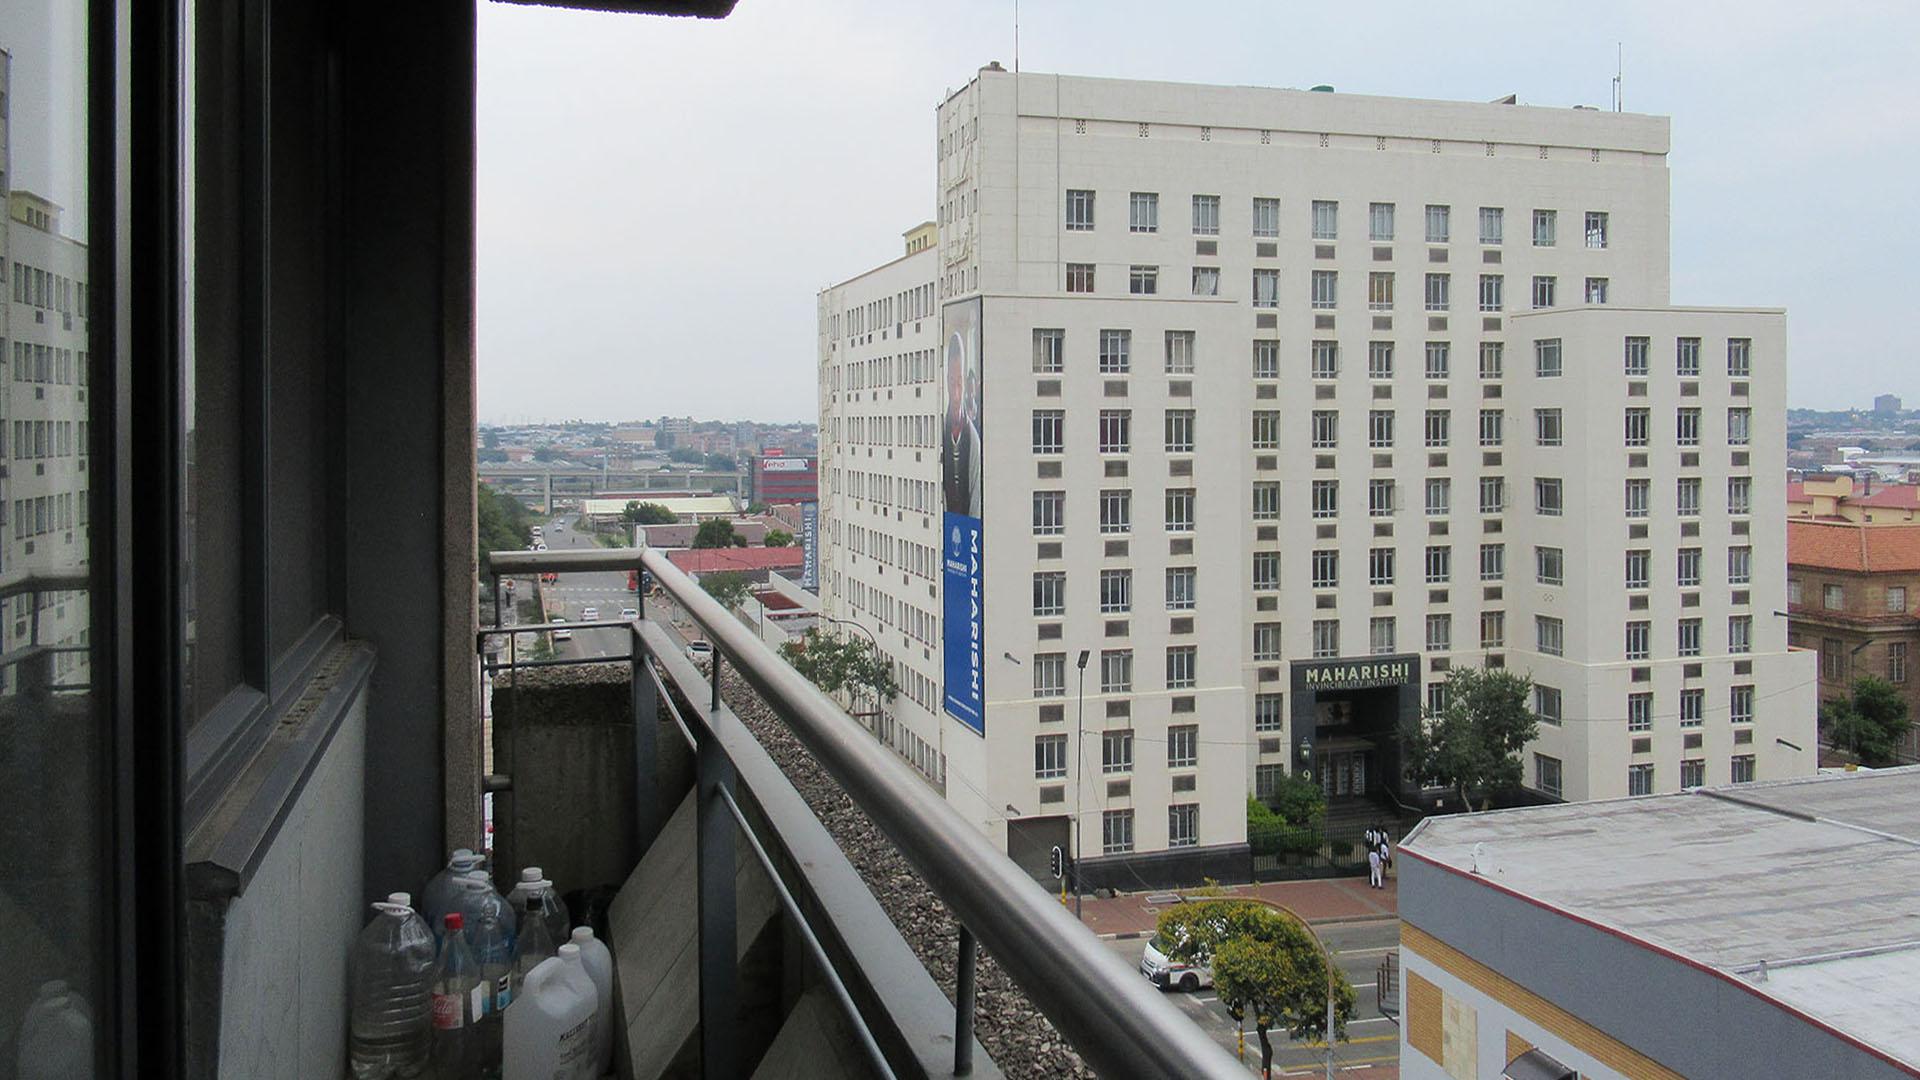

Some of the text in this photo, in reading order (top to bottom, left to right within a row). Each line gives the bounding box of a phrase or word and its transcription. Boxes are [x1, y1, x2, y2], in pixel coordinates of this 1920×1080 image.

[970, 529, 979, 701] MAHARISHI
[1305, 663, 1409, 683] MAHARISHI
[1306, 677, 1408, 691] INVINCIBILITY INSTITUTE
[1302, 769, 1311, 782] 9
